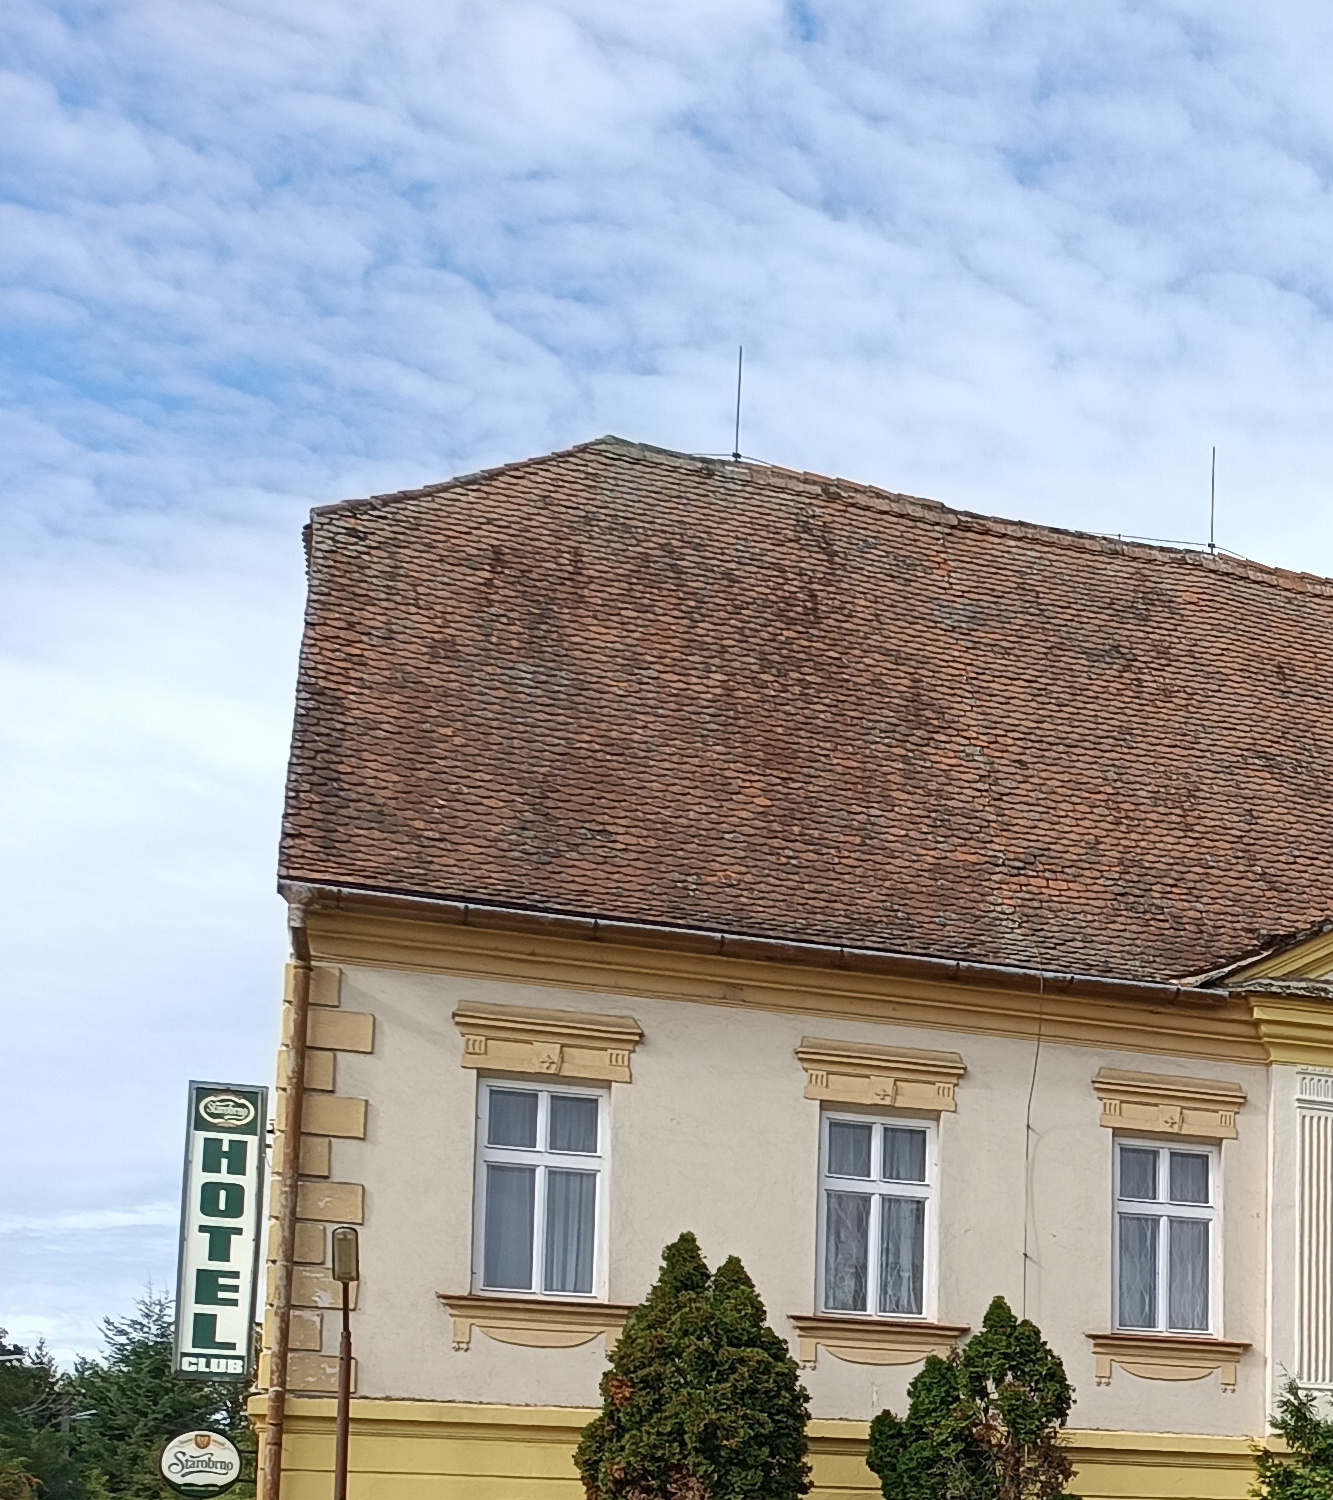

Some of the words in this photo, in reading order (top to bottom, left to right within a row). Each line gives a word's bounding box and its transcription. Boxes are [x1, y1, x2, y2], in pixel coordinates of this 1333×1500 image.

[191, 1138, 248, 1351] HOTEL
[181, 1357, 244, 1374] CLUB
[168, 1451, 233, 1475] Starobrno
